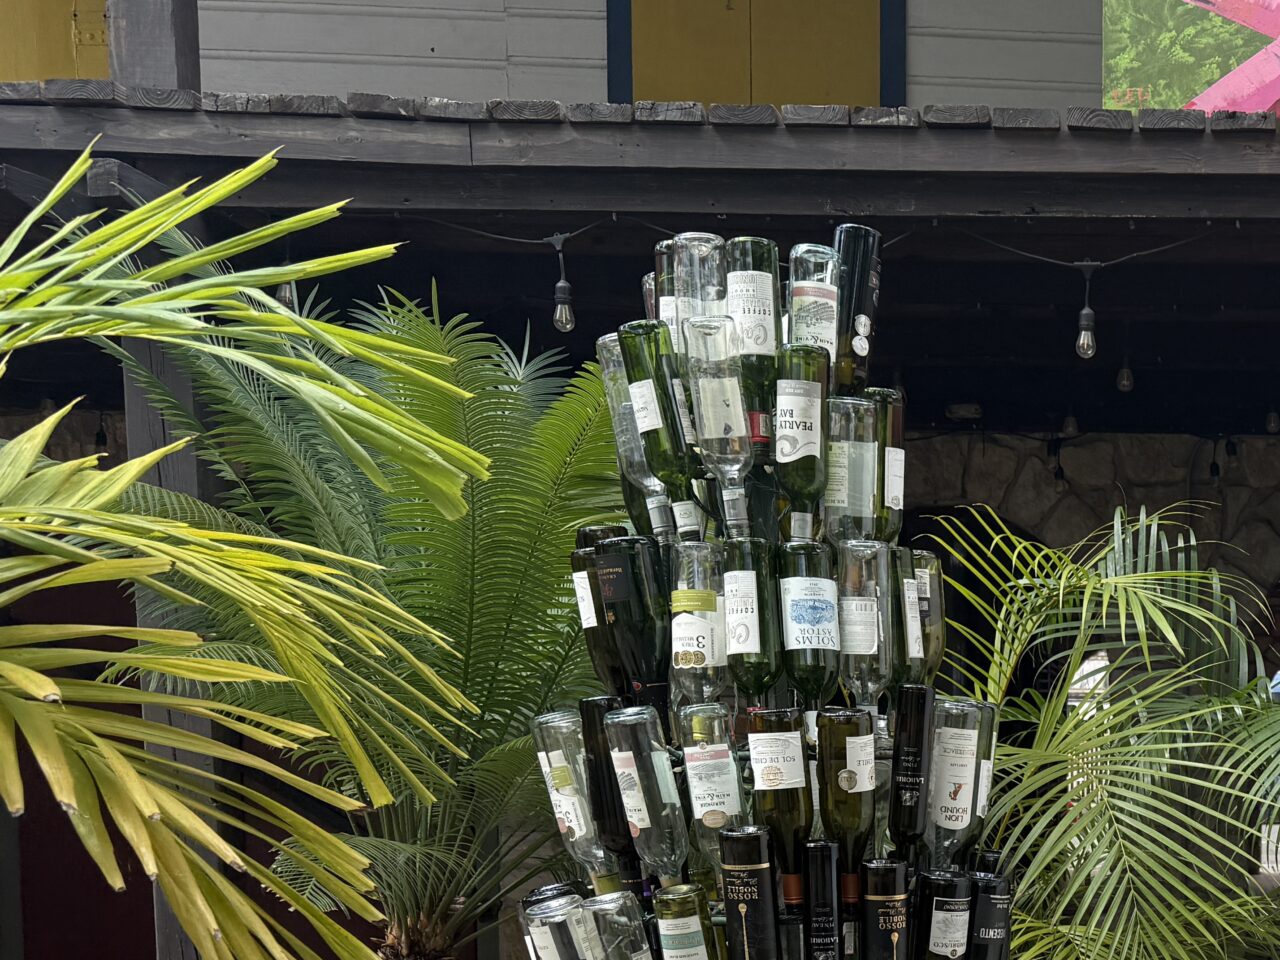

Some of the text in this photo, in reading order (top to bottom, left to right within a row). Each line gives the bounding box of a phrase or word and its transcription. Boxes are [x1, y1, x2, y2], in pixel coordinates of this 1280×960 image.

[741, 306, 772, 317] COFFEE
[778, 408, 794, 419] BAY
[777, 420, 814, 432] PEARLY
[798, 627, 833, 637] ASTOR
[694, 635, 706, 650] 3
[794, 635, 837, 648] SOLMS
[782, 755, 796, 763] SOL
[939, 805, 968, 816] HOUND
[944, 814, 964, 824] LION
[727, 892, 758, 900] ROSSO
